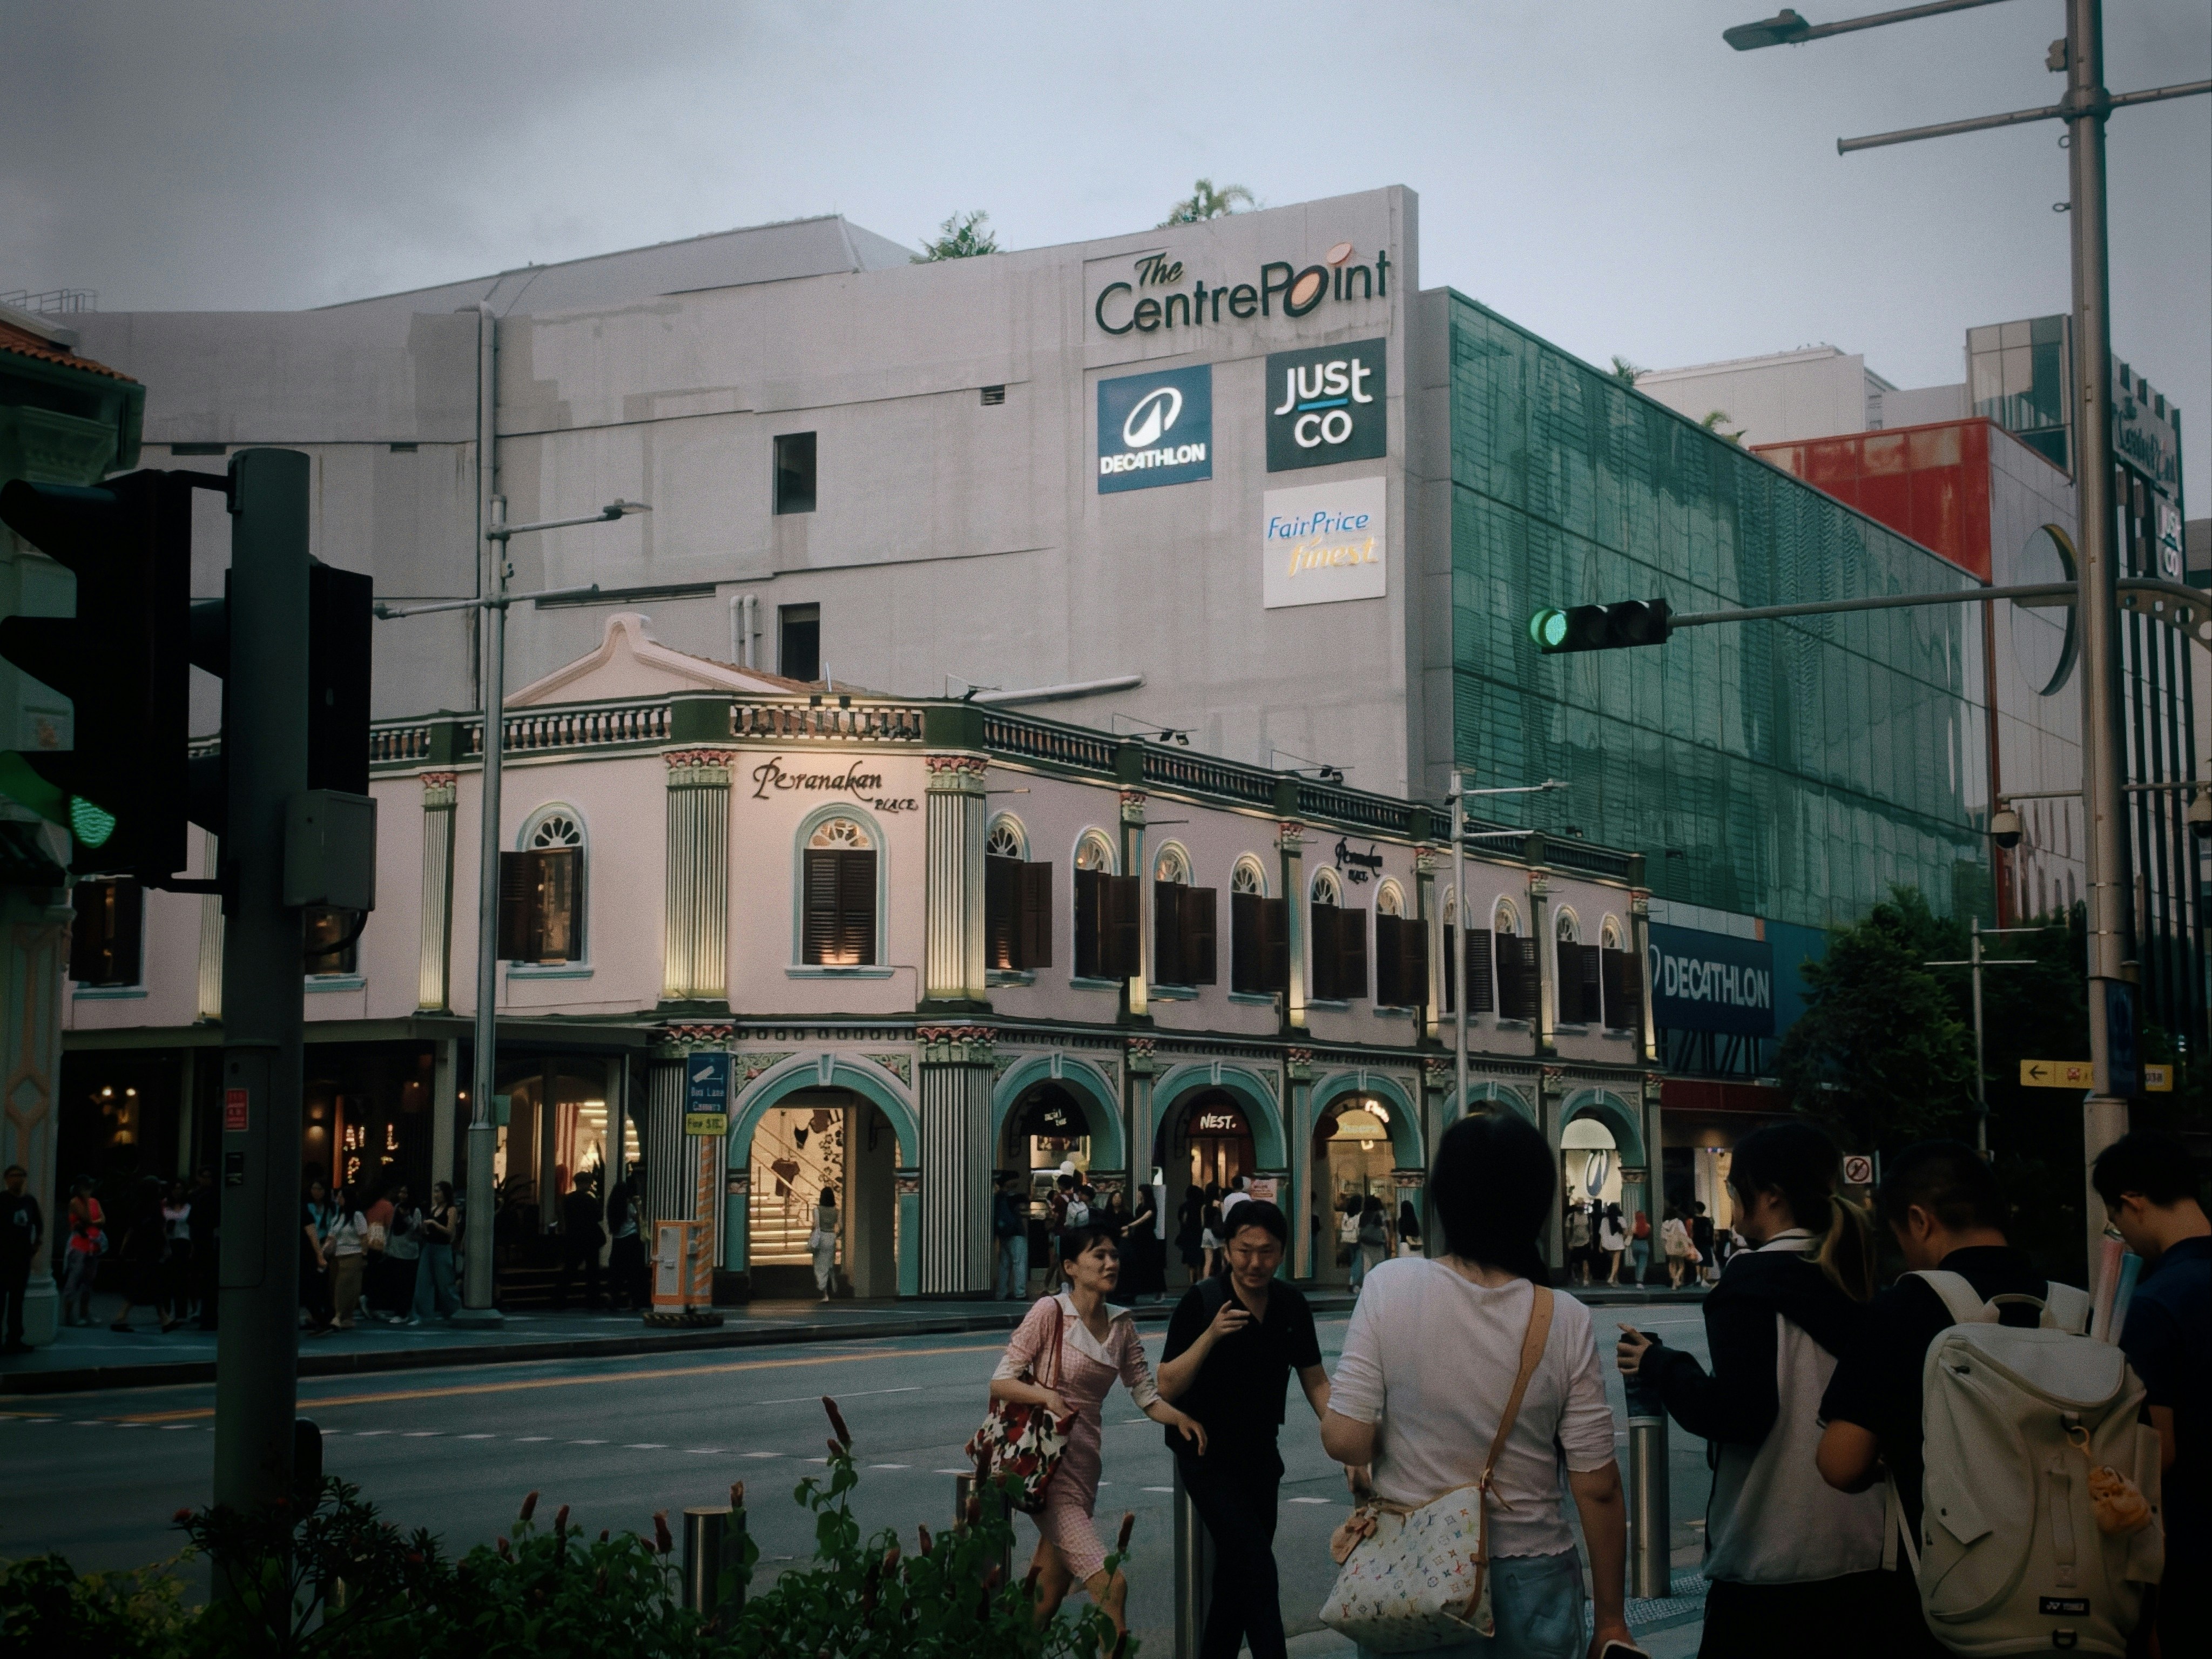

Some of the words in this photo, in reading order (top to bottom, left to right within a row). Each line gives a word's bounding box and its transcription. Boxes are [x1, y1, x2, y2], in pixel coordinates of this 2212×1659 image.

[1095, 242, 1392, 335] CentrePoint
[1134, 252, 1184, 287] The
[1100, 443, 1206, 475] DECATHLON
[1267, 511, 1370, 539] FairPrice
[1288, 536, 1379, 579] finest
[752, 756, 882, 801] Peranakan
[1663, 954, 1770, 1009] DECATHLON
